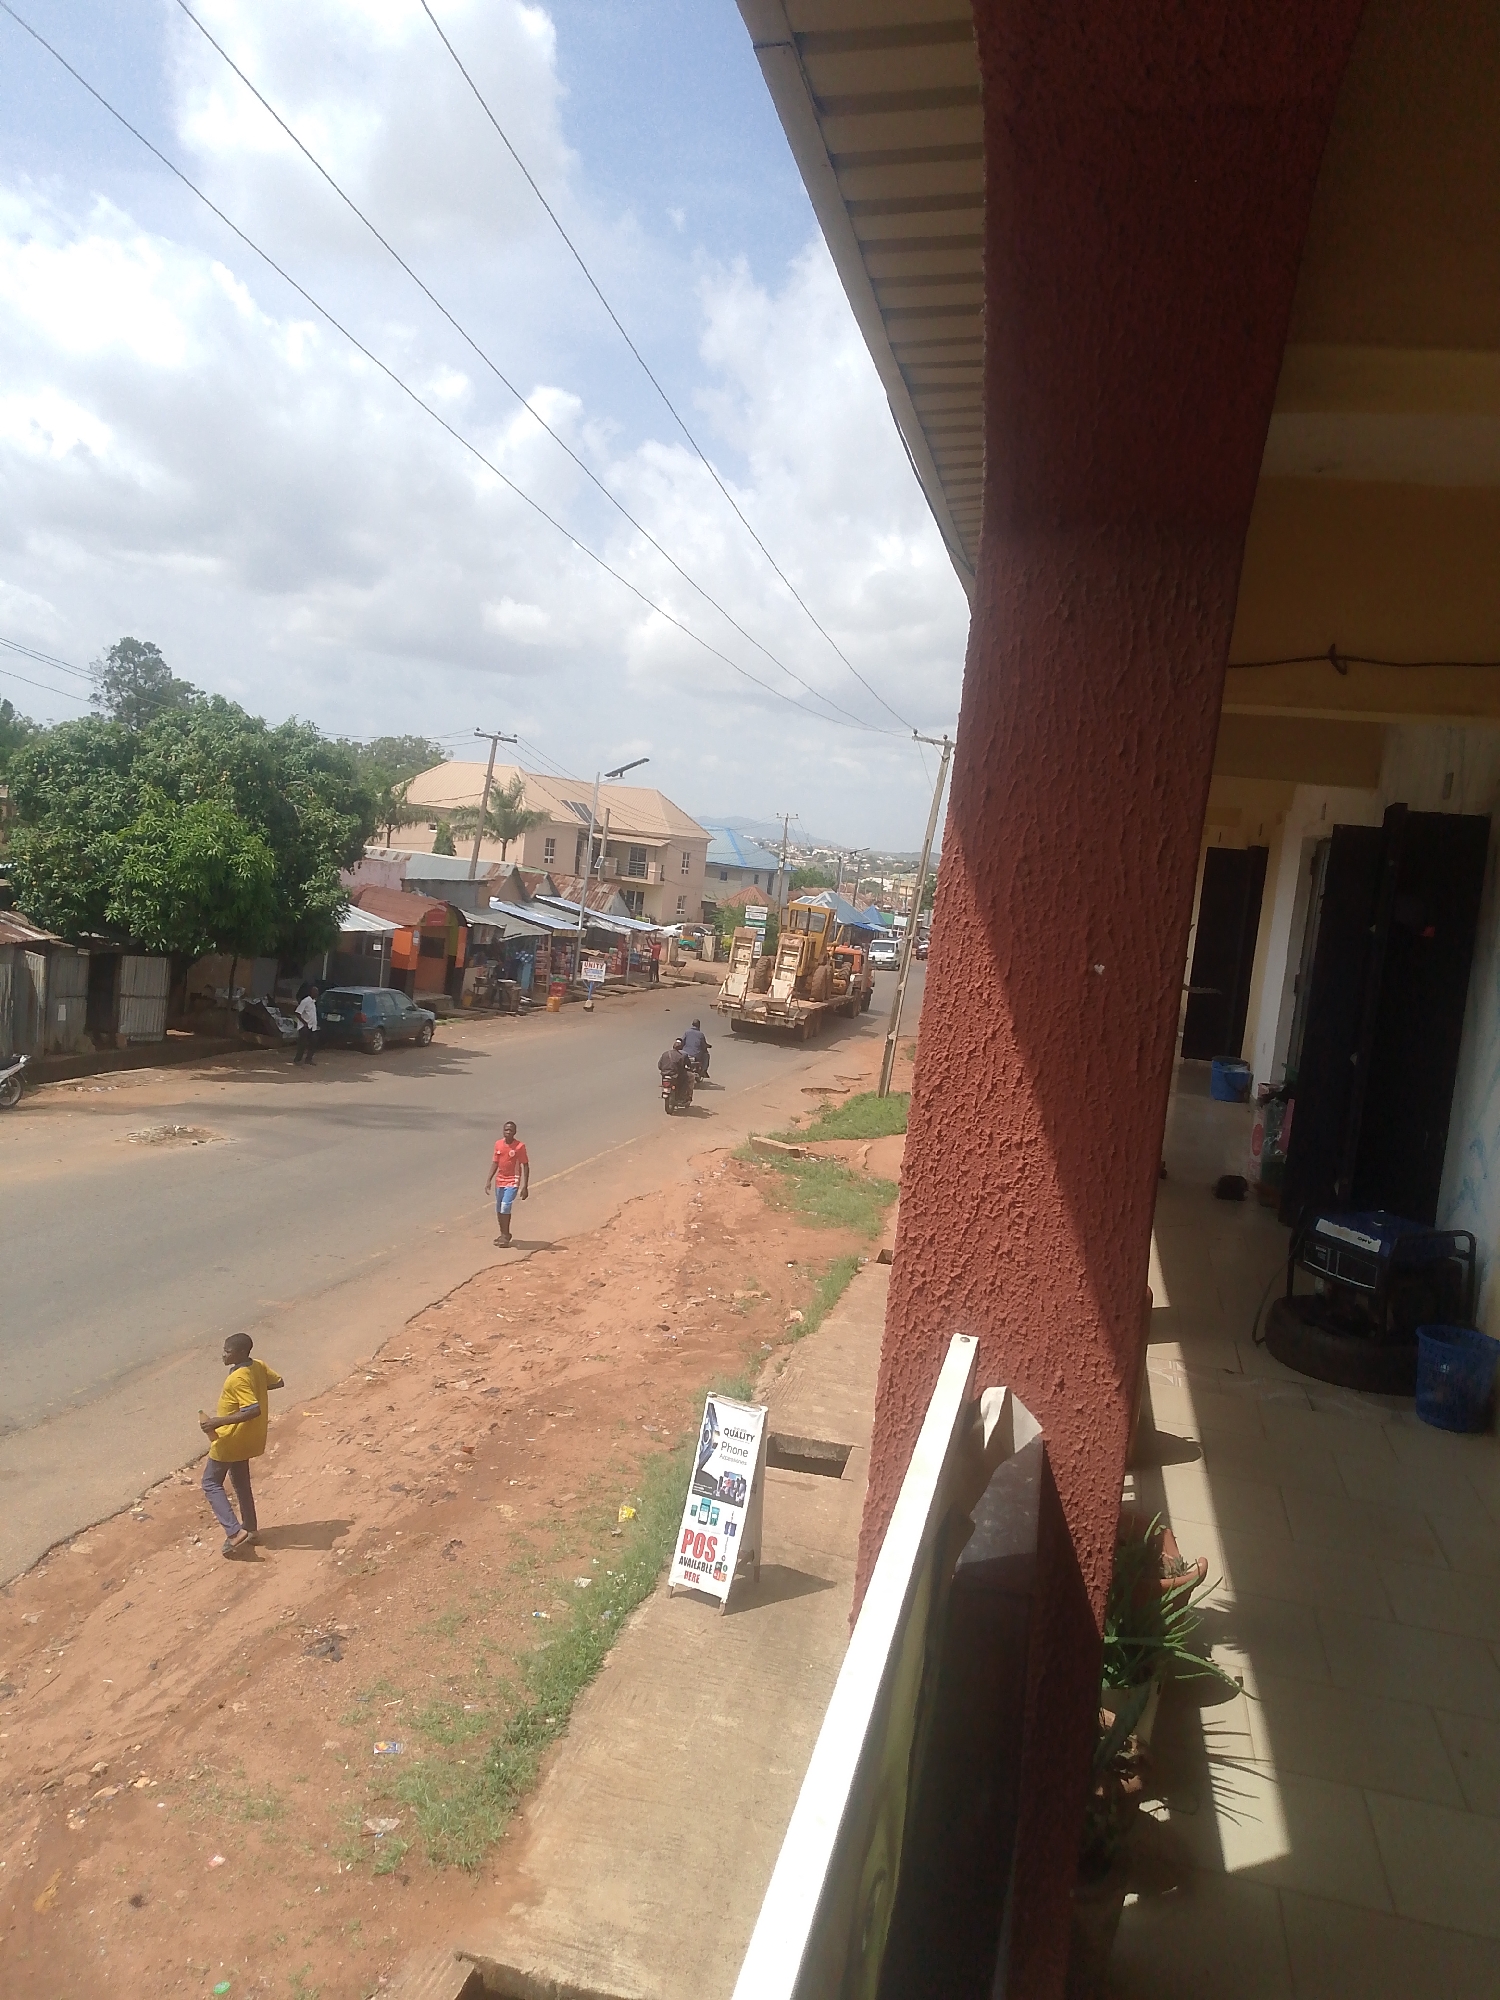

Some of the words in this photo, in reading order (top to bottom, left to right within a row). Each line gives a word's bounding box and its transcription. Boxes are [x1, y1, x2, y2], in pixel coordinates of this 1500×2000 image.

[584, 962, 604, 970] UNITY
[724, 1428, 755, 1442] QUALITY
[721, 1441, 749, 1458] Phone
[681, 1529, 718, 1562] POS
[679, 1556, 713, 1575] AVAILABLE
[684, 1570, 701, 1584] HERE
